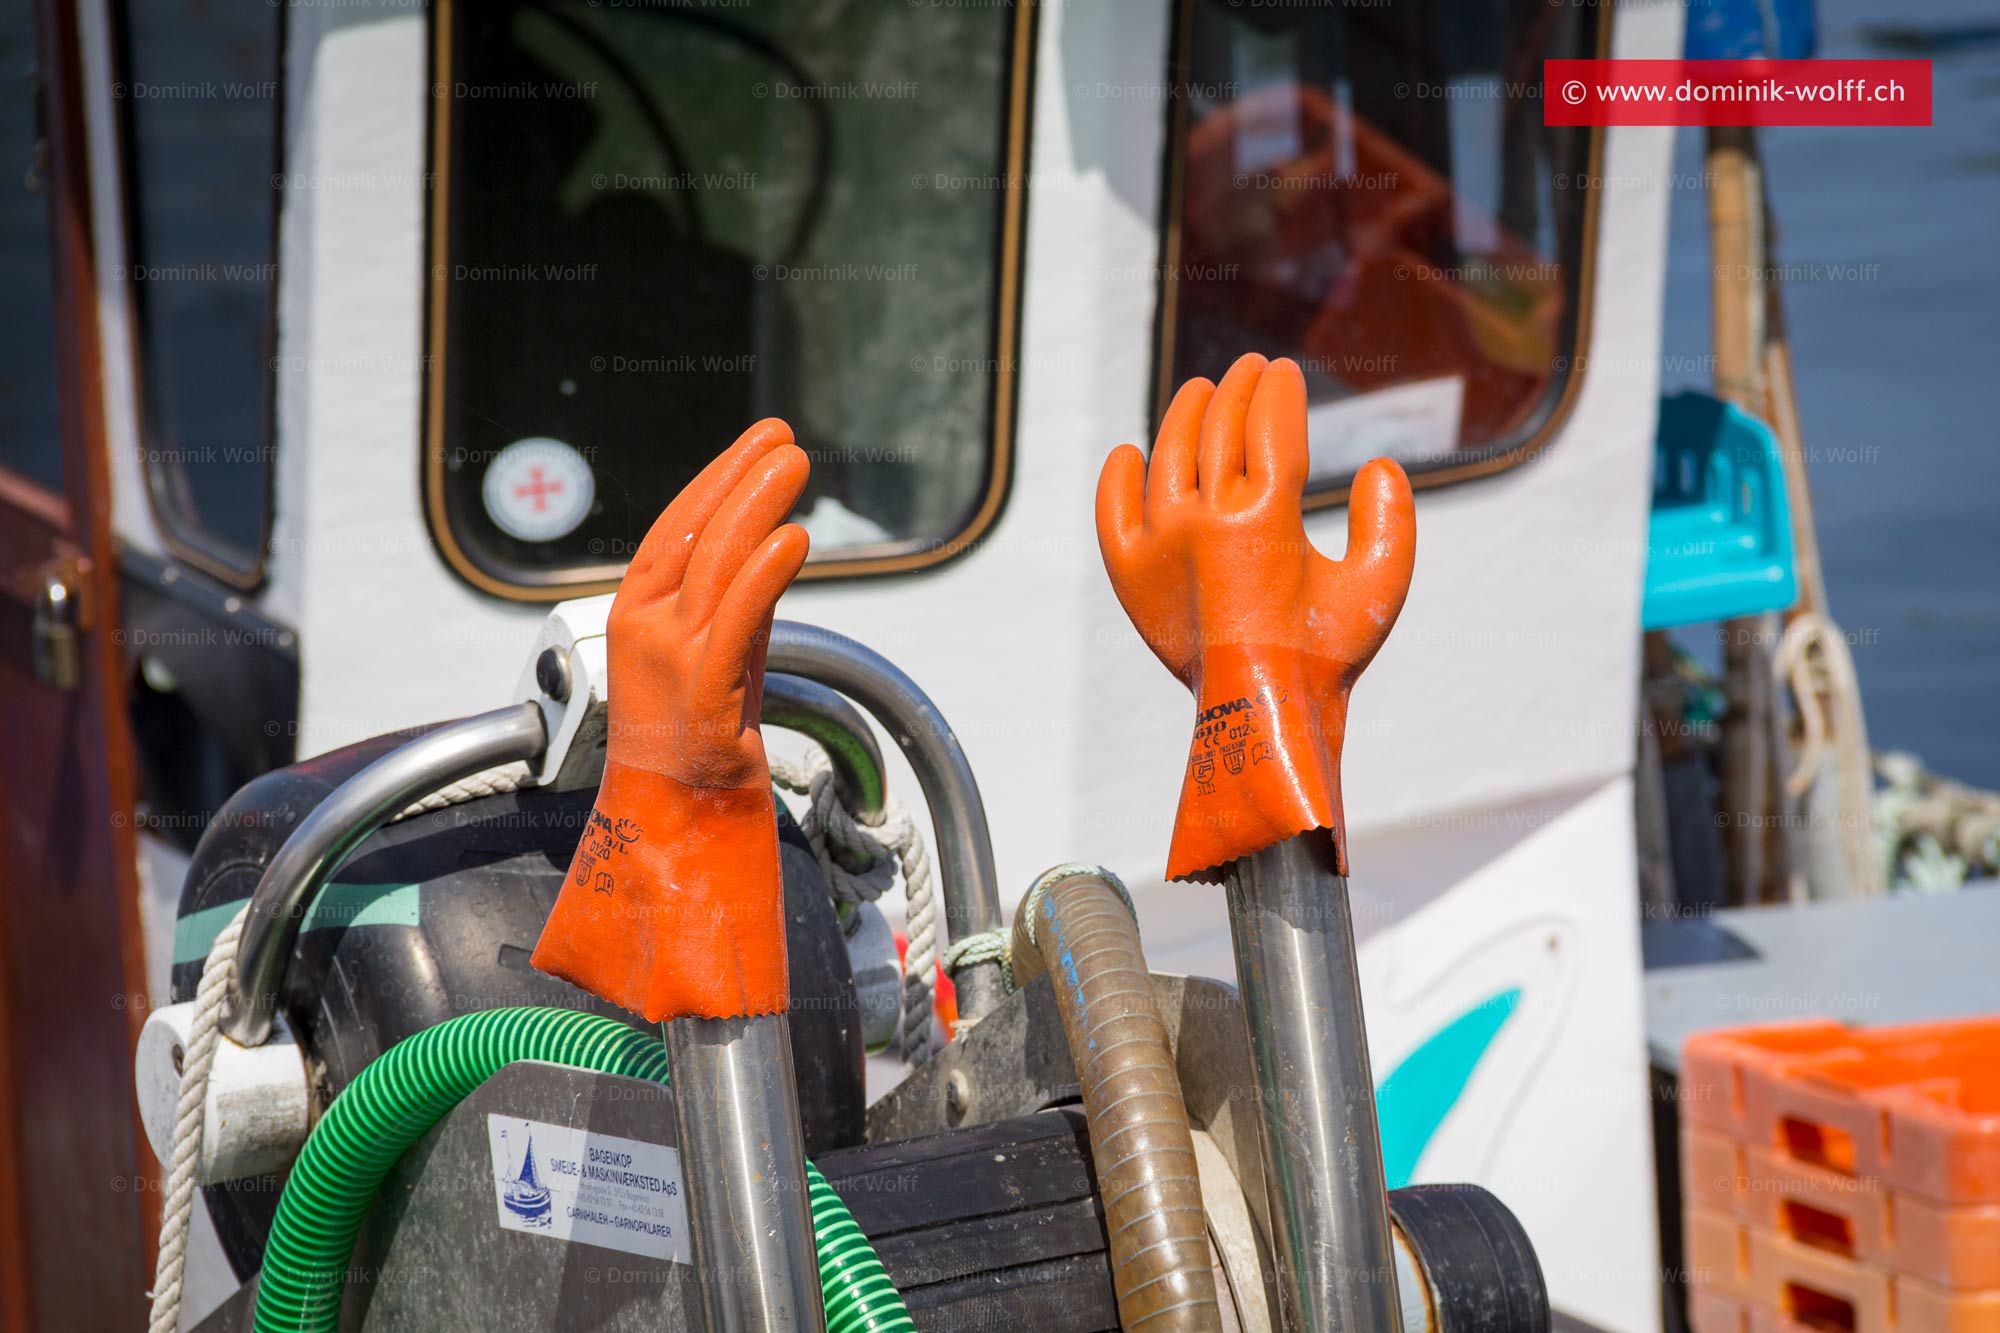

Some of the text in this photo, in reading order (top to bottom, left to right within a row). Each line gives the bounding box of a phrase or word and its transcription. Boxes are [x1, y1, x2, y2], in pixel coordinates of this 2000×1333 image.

[1196, 697, 1254, 727] HOWA
[590, 840, 611, 861] 0120
[589, 1147, 632, 1168] BAGENKOP
[550, 1158, 580, 1176] SMEDE-
[581, 1164, 587, 1178] &
[588, 1165, 660, 1192] MASKINVÆRKSTED
[662, 1180, 678, 1198] ApS
[614, 1215, 672, 1239] GARNOPKLARER
